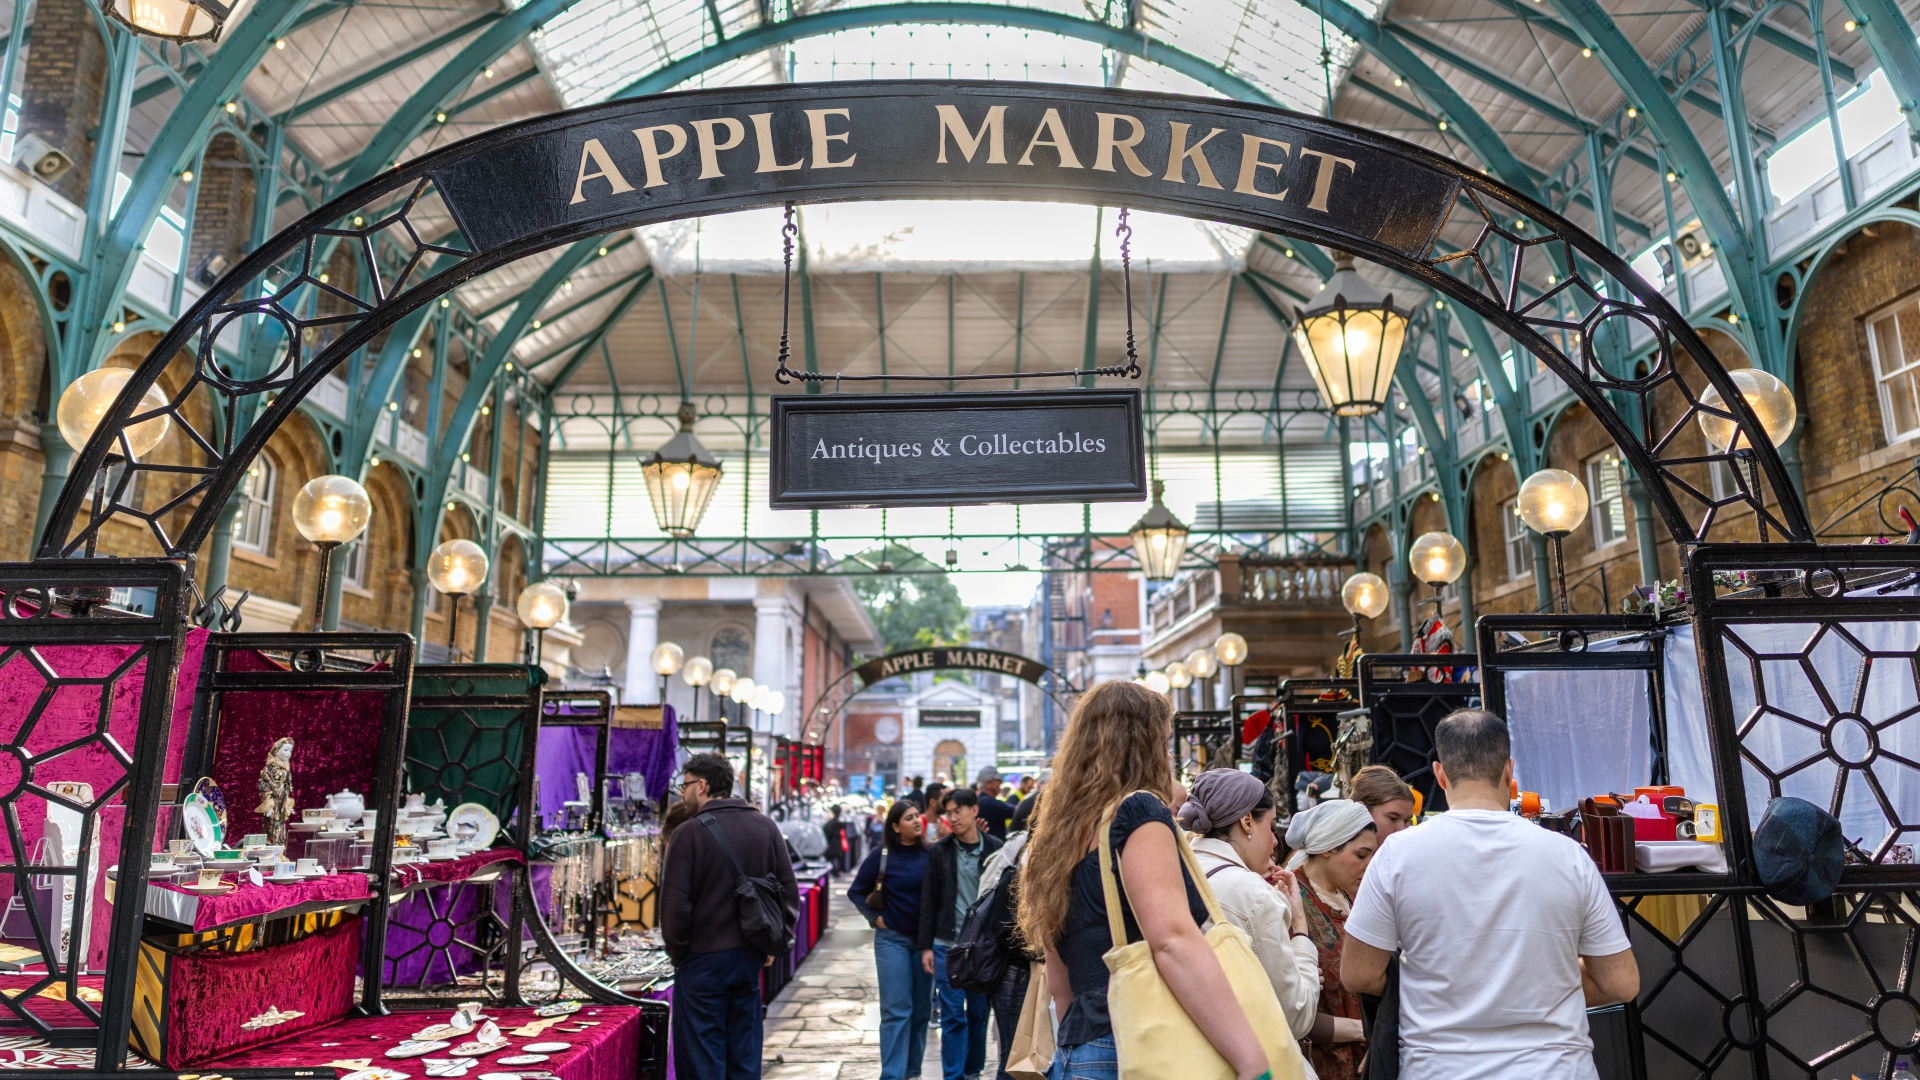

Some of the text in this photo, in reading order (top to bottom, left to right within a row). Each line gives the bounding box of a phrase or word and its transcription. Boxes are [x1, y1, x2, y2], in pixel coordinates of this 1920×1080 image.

[569, 104, 1356, 213] APPLE MARKET
[811, 431, 1106, 465] Antiques & Collectables
[882, 652, 1025, 676] APPLE MARKET
